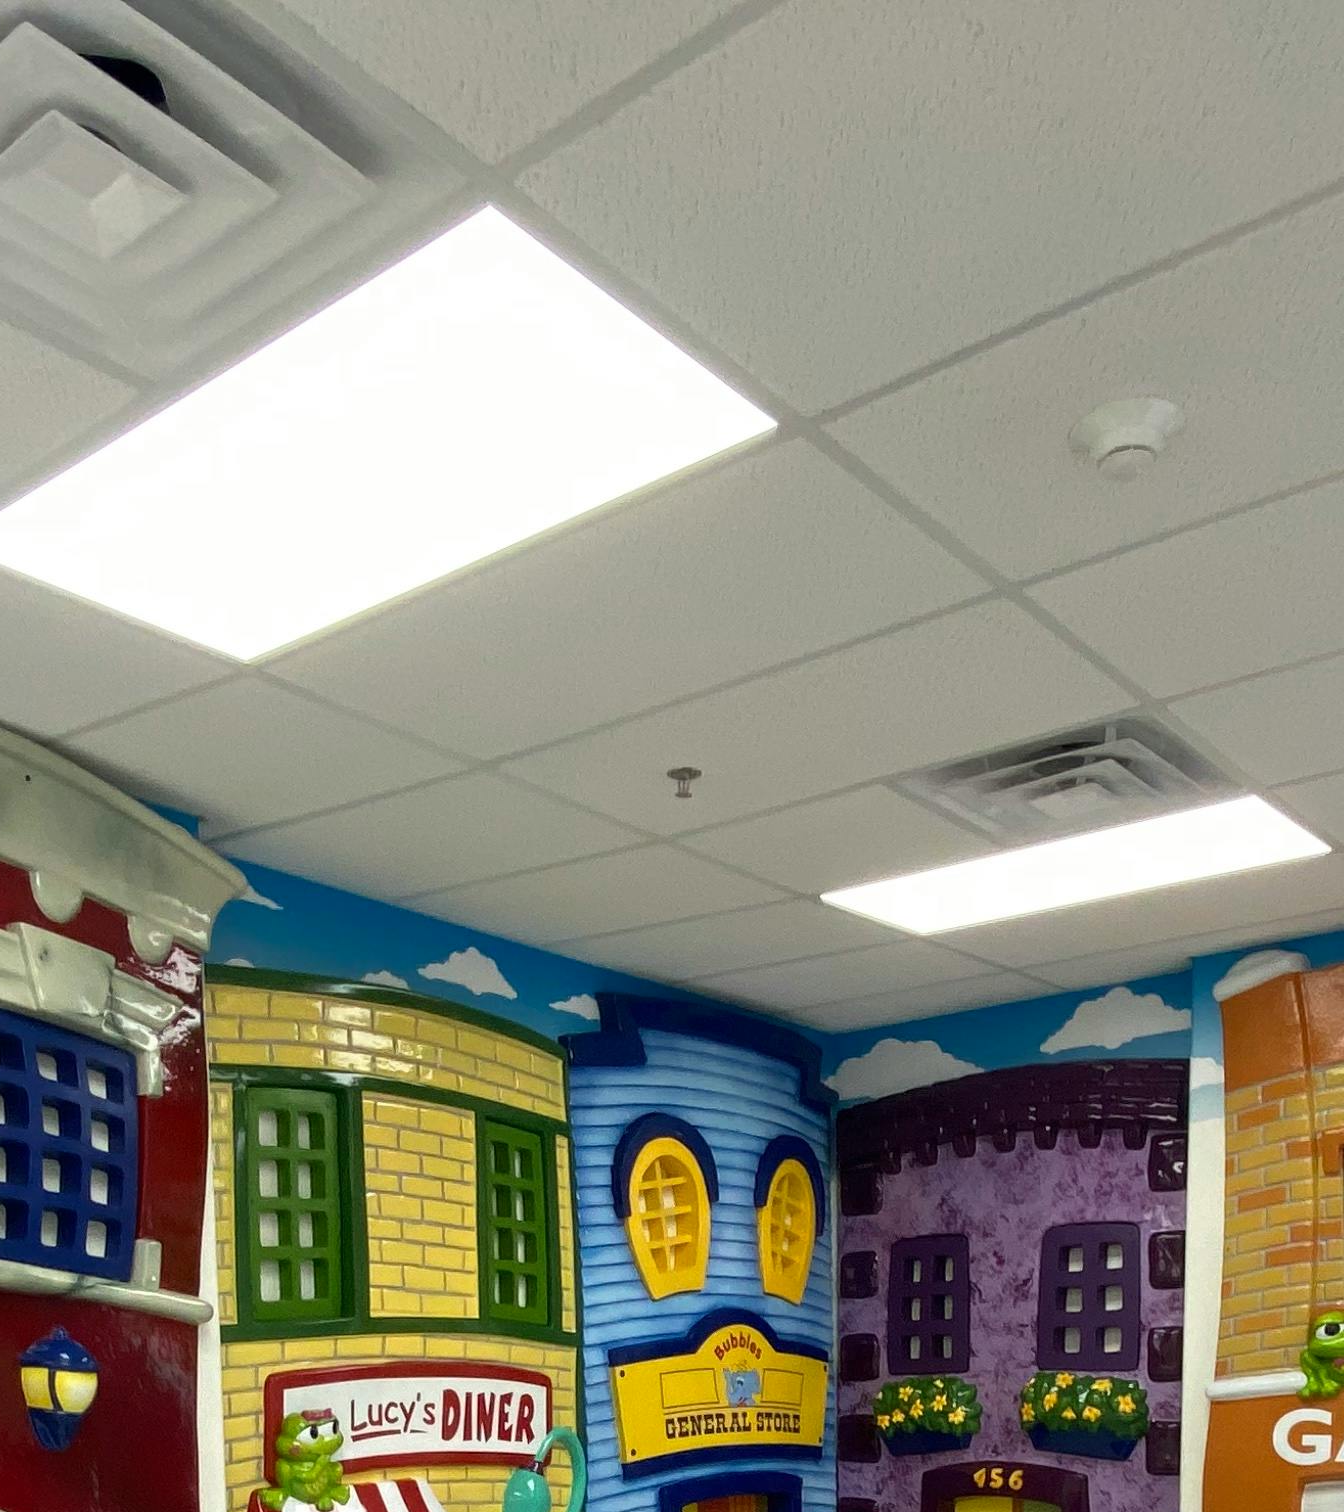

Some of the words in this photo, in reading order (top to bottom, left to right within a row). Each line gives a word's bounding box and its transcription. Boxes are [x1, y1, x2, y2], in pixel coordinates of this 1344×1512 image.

[714, 1332, 763, 1361] Bubbles
[350, 1392, 436, 1433] Lucy's
[441, 1388, 535, 1444] DINER
[665, 1411, 752, 1439] GENERAL
[756, 1412, 801, 1434] STORE
[973, 1467, 1024, 1491] 456
